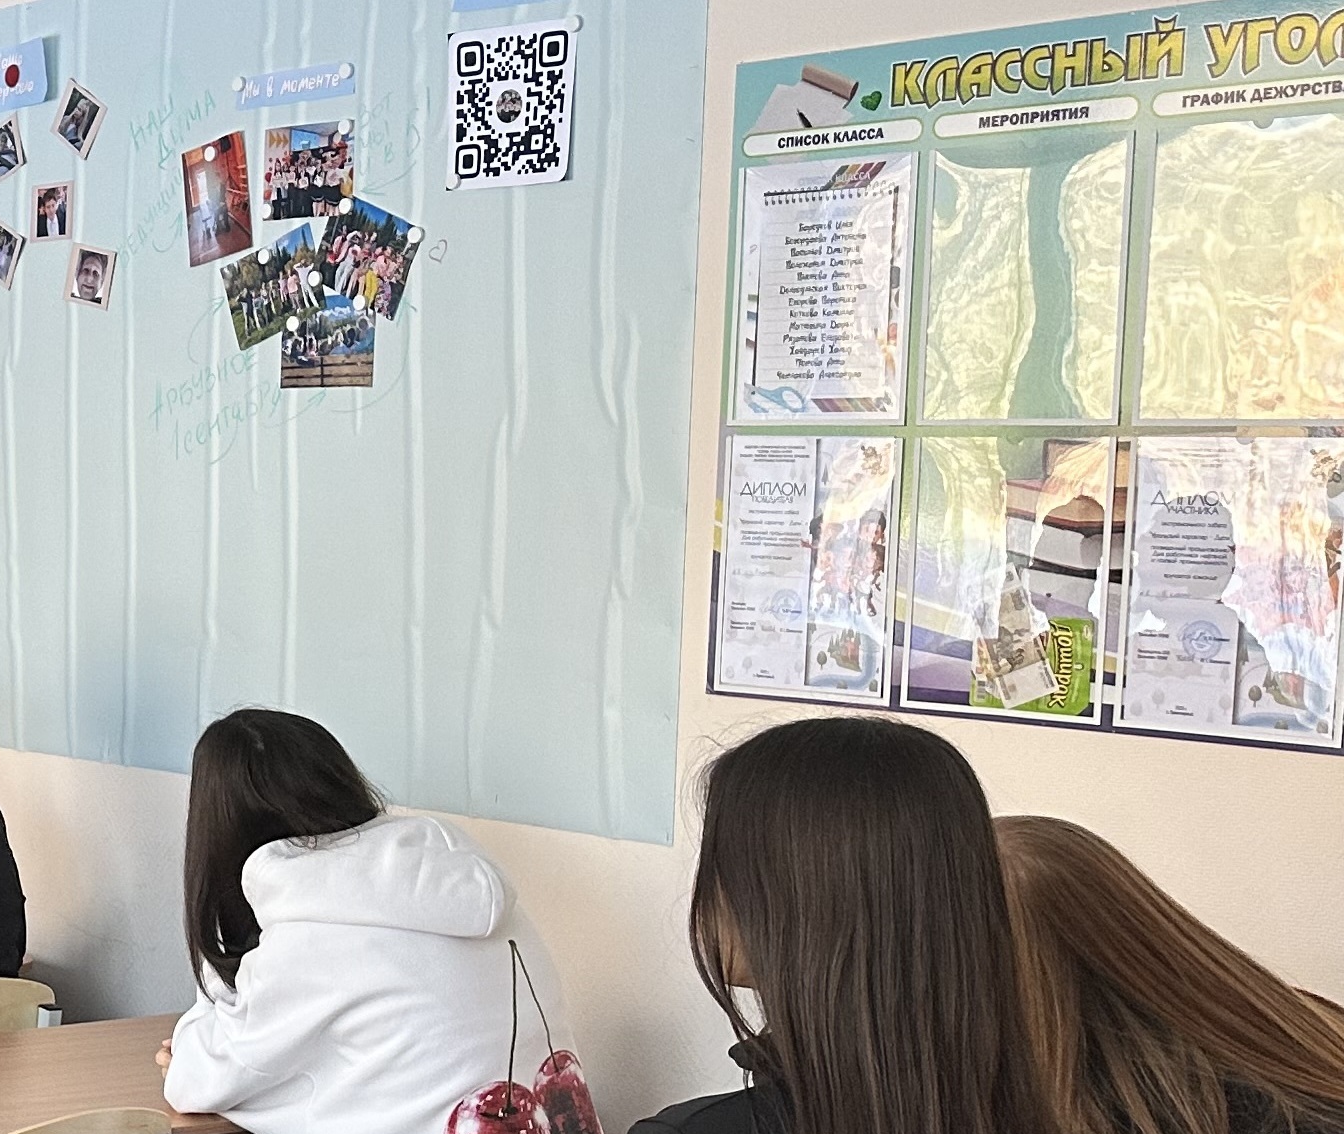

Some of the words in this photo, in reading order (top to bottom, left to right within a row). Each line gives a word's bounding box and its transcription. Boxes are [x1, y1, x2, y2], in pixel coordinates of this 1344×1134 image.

[890, 14, 1186, 109] КЛАССНЫЙ
[241, 82, 260, 104] Мы
[266, 78, 274, 99] в
[280, 72, 340, 93] моменте
[1182, 89, 1246, 108] ГРАФИК
[1250, 79, 1344, 104] ДЕЖУРСТВ
[978, 106, 1089, 129] МЕРОПРИЯТИЯ
[777, 133, 830, 149] СПИСОК
[833, 127, 885, 144] КЛАССА
[739, 481, 807, 497] ДИПЛОМ
[1150, 490, 1236, 506] ДПЛОМ
